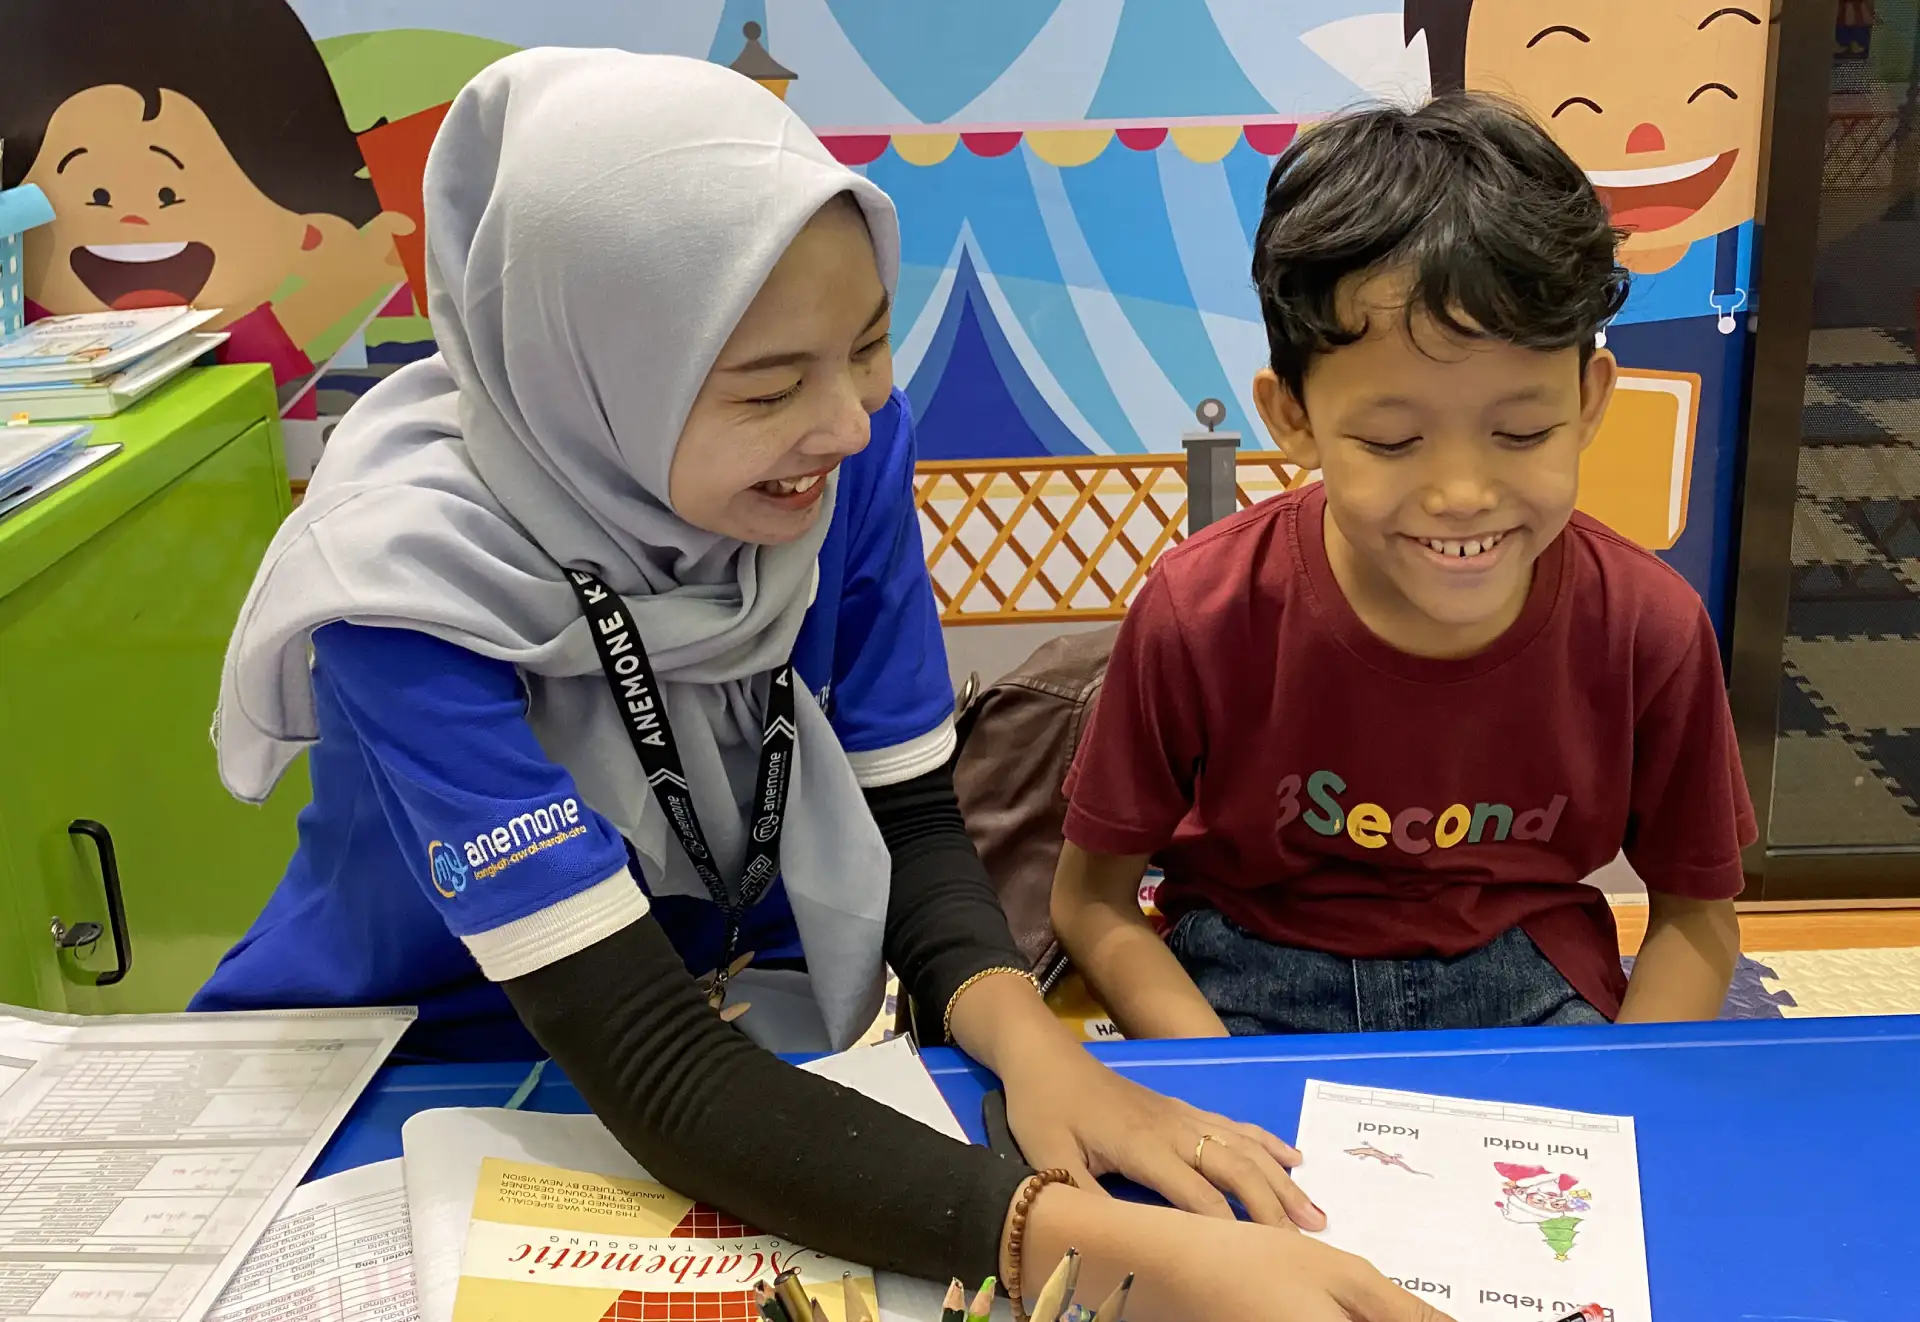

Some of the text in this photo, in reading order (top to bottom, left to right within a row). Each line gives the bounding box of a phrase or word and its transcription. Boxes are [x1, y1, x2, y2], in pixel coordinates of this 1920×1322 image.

[598, 610, 666, 747] ANEMONE
[763, 751, 782, 811] anemone
[463, 798, 580, 868] anemone
[1357, 1121, 1420, 1140] kadal
[1483, 1136, 1589, 1160] hari natal
[501, 1180, 633, 1203] BY THE YOUNG DESIGNER
[502, 1172, 665, 1200] MANUFACTURED BY NEW VISION
[498, 1195, 639, 1219] THIS BOOK WAS SPECIALLY
[499, 1187, 641, 1211] DESIGNED FOR THE YOUNG
[549, 1235, 794, 1253] OTAK TANGGUNG
[1479, 1290, 1544, 1313] tebal
